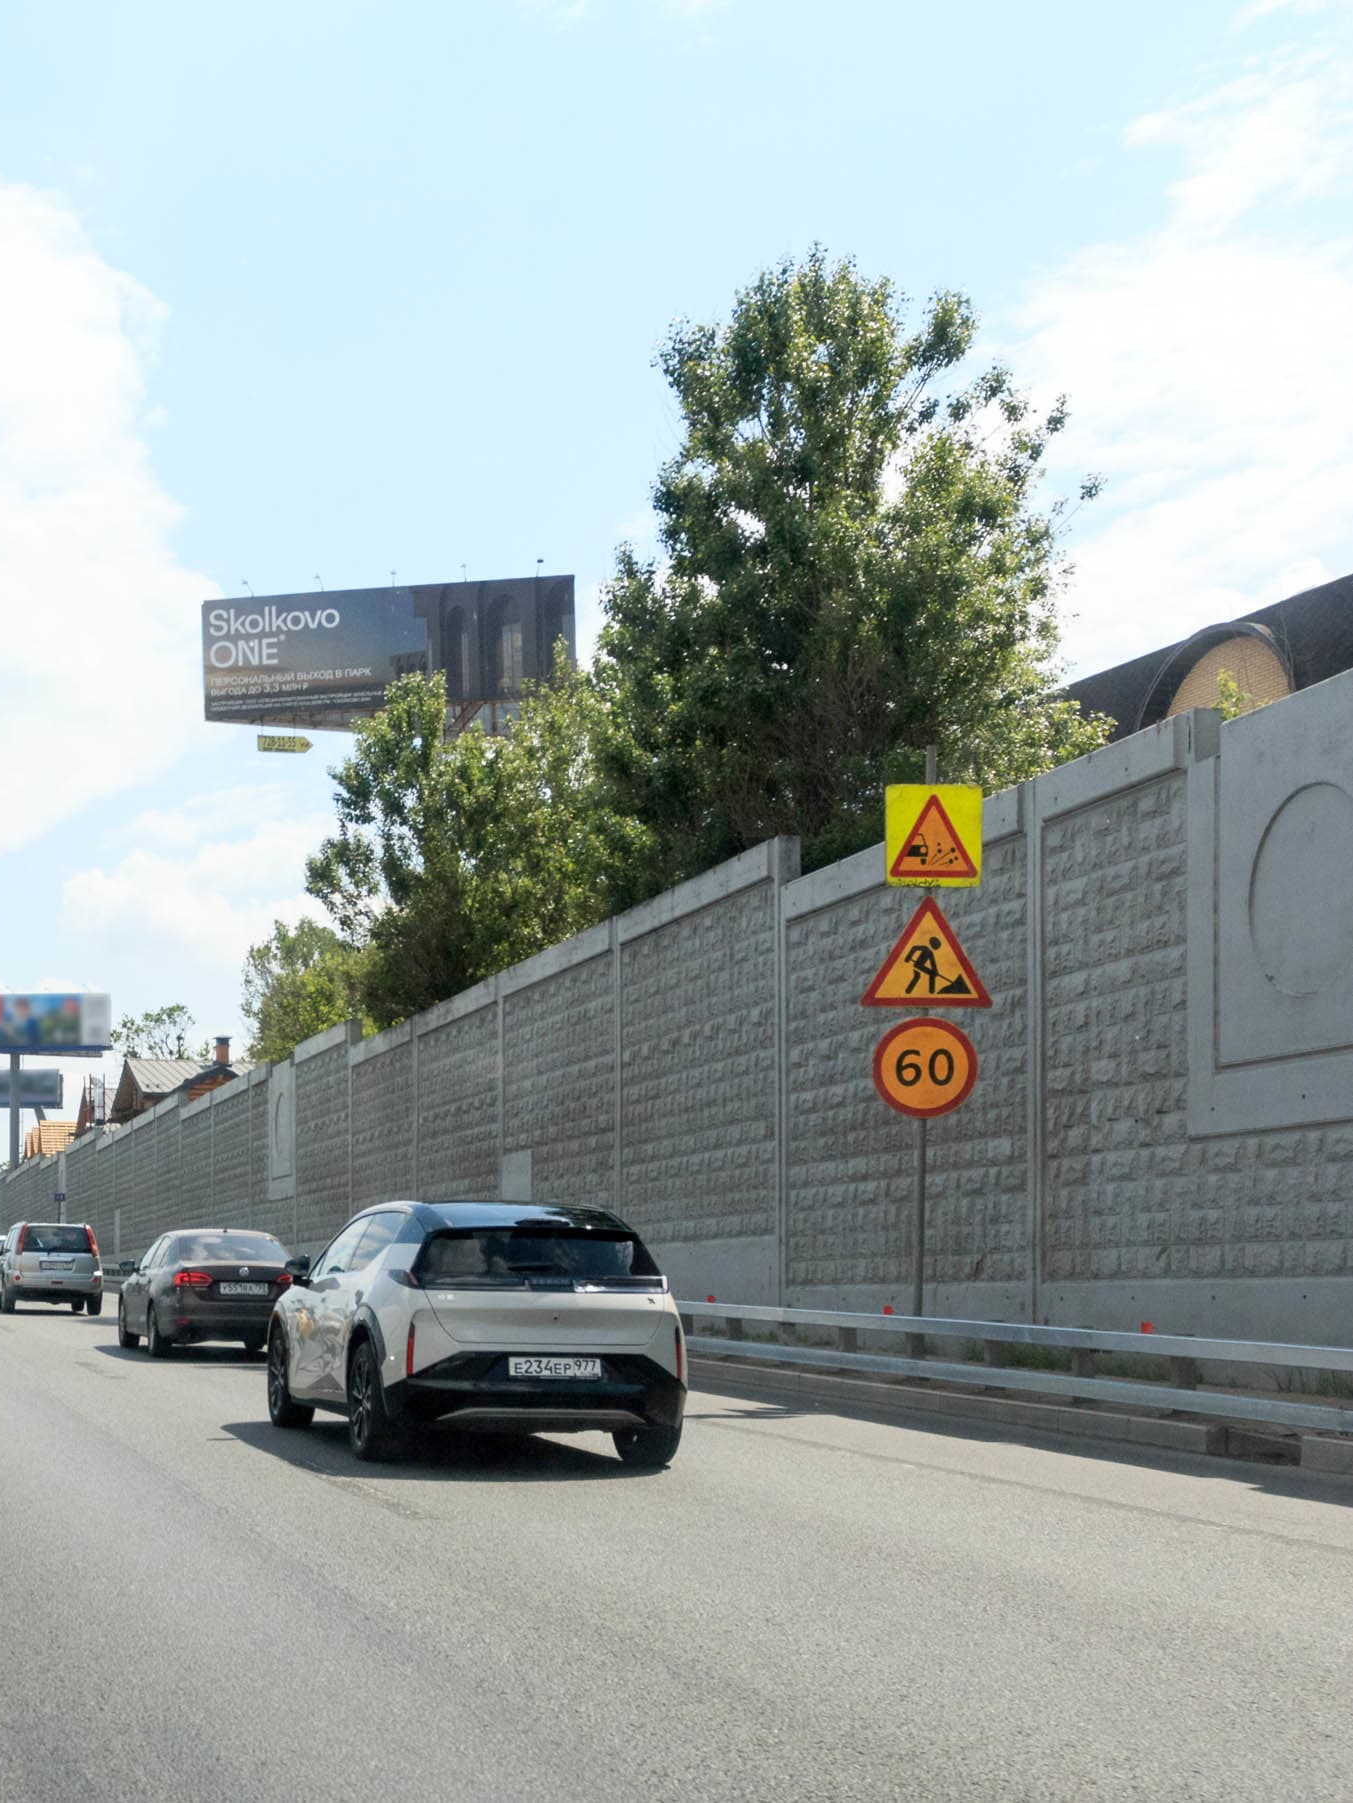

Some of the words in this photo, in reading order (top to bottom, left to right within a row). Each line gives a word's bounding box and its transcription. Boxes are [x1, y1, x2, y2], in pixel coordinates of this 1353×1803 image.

[209, 605, 340, 636] Skolkovo
[210, 638, 279, 668] ONE
[210, 671, 295, 686] ПЕРСОНАЛЬНЫЙ
[296, 669, 333, 681] ВЫХОД
[335, 669, 343, 679] В
[344, 667, 372, 678] ПАРК
[895, 1048, 955, 1087] 60
[574, 1359, 596, 1372] 977
